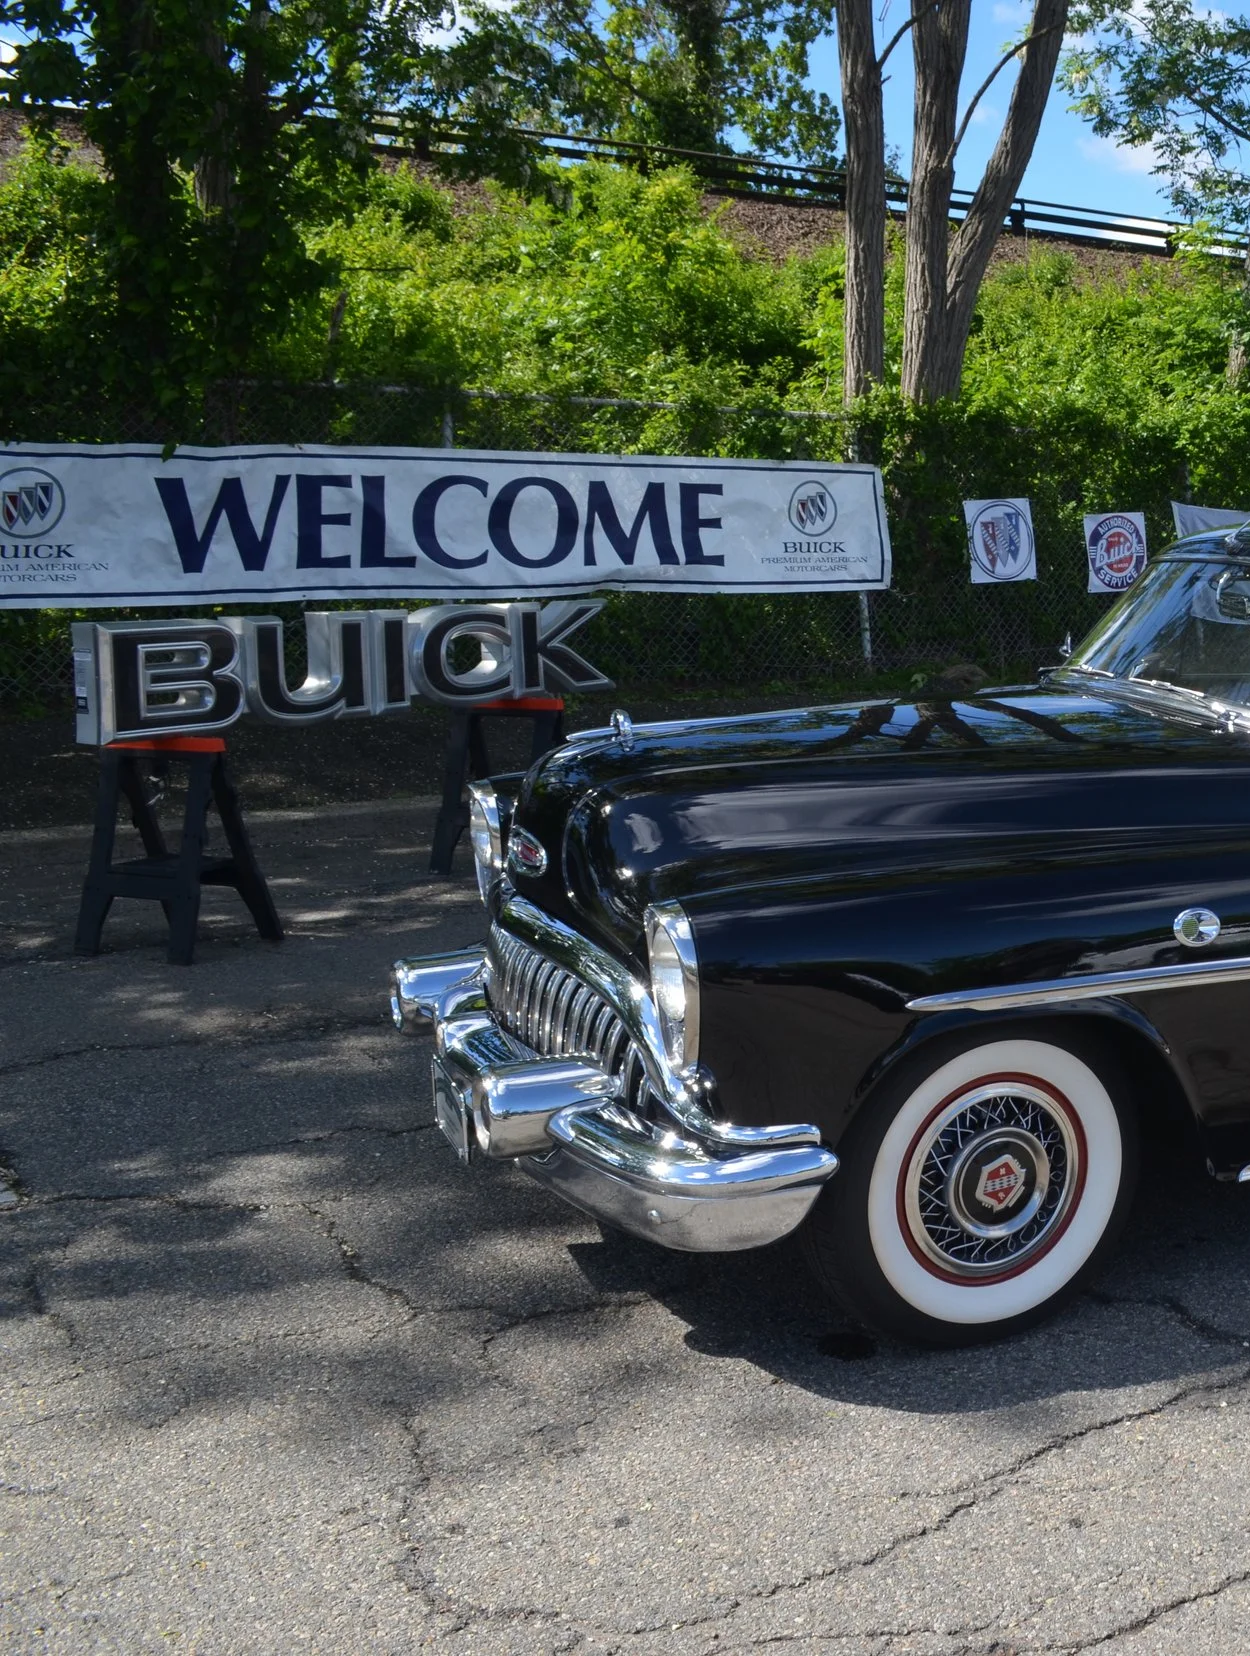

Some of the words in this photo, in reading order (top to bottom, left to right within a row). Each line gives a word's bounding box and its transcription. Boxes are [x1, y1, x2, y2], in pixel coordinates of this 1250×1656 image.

[154, 474, 726, 574] WELCOME
[1098, 517, 1135, 535] AUTHORIZED
[0, 544, 75, 559] UICK
[782, 541, 846, 553] BUICK
[1095, 531, 1140, 568] Buick
[25, 562, 109, 572] AMERICAN
[0, 573, 77, 582] TORCARS
[1098, 568, 1138, 587] SERVICE
[84, 598, 615, 745] BUICK
